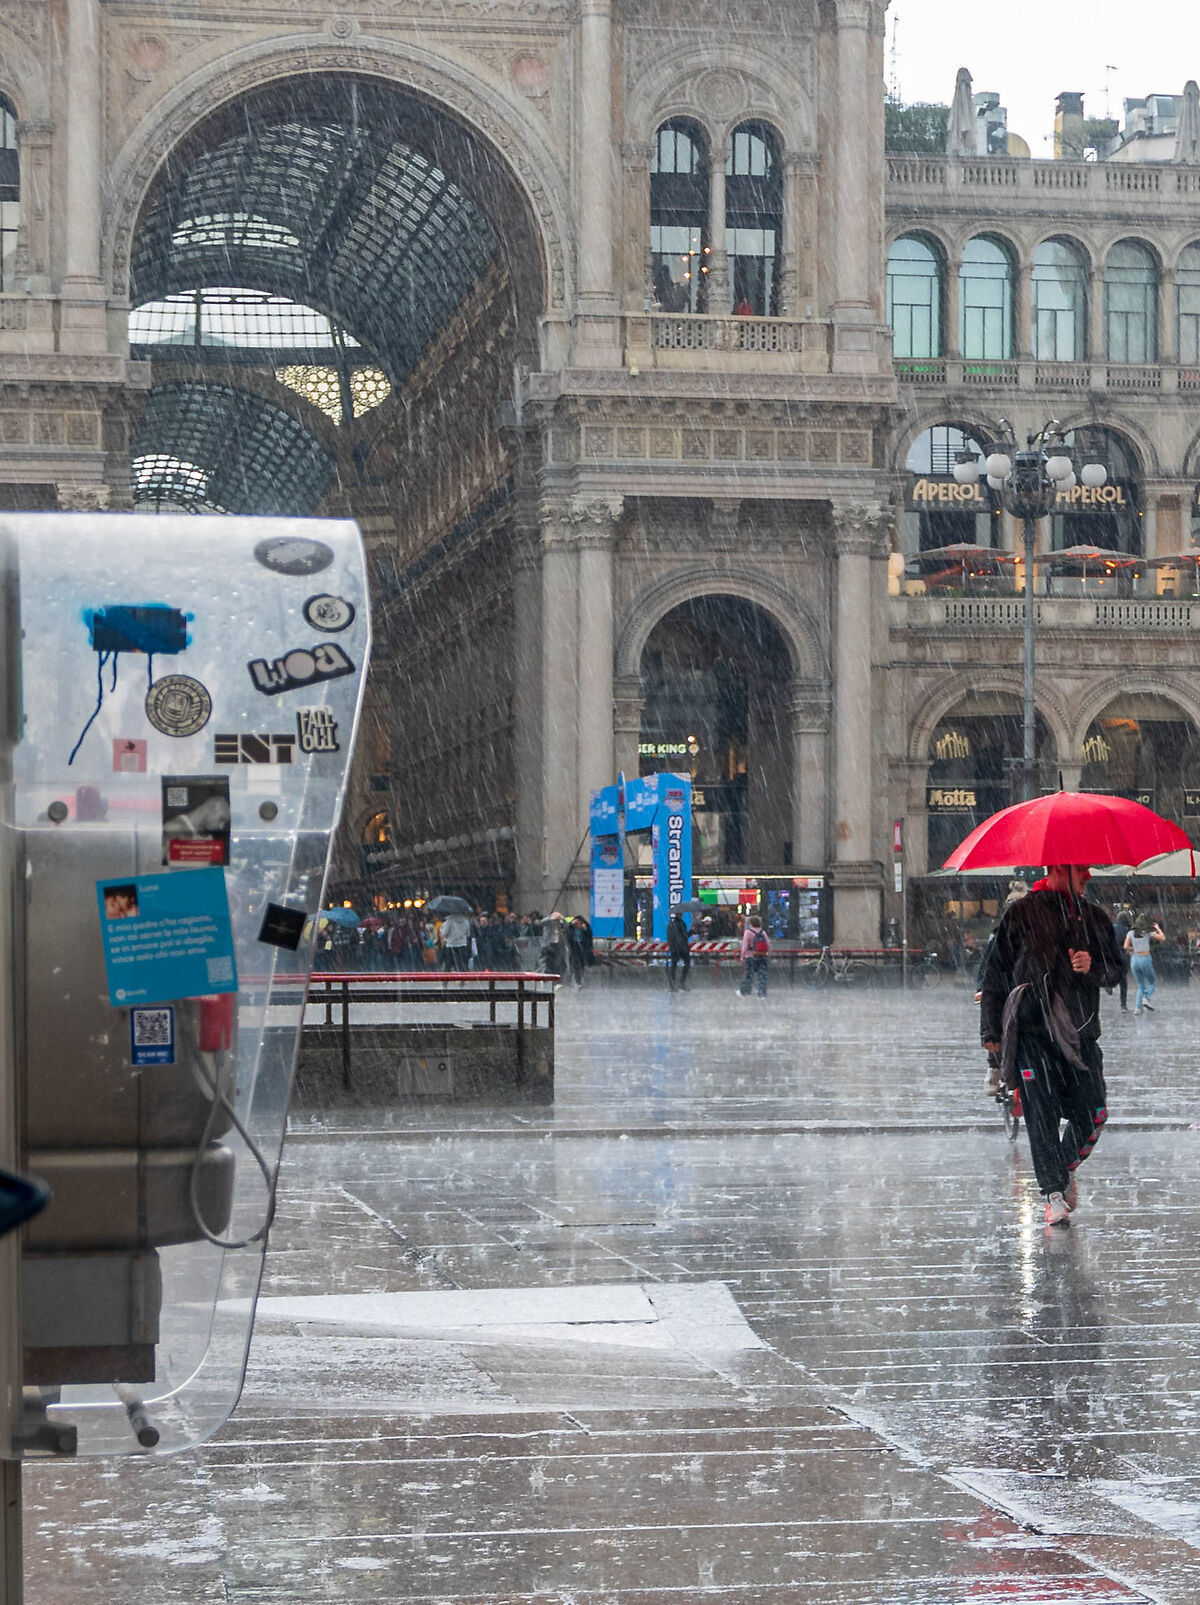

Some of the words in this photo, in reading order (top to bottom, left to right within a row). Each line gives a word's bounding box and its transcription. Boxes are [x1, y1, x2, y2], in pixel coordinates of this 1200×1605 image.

[912, 479, 984, 501] APEROL
[214, 734, 296, 764] ENT
[657, 744, 686, 754] KING
[929, 789, 977, 806] Motta
